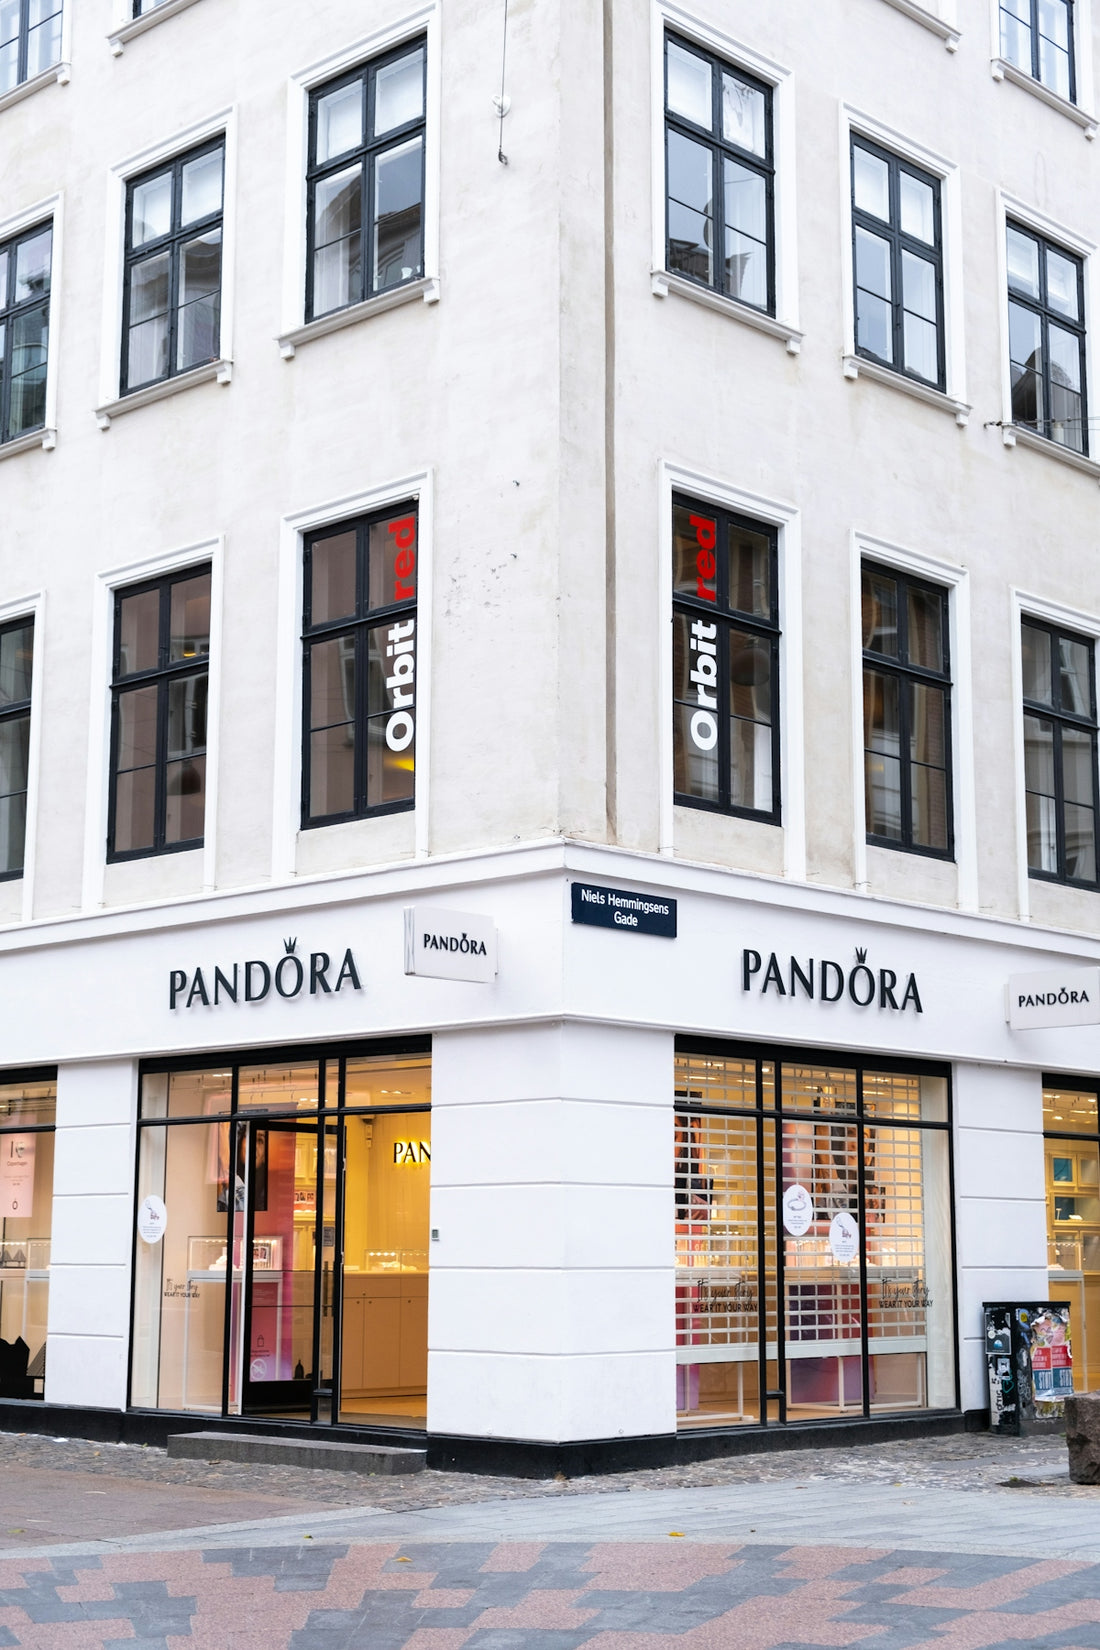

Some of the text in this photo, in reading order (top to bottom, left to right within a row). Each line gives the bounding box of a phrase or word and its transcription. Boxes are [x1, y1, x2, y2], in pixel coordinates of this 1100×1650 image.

[388, 516, 415, 600] red
[689, 515, 716, 602] red
[581, 888, 670, 915] Niels Hemmingsens
[613, 911, 639, 926] Gade
[424, 932, 487, 956] PANDORA
[169, 938, 362, 1010] PANDORA
[742, 947, 924, 1014] PANDORA
[1018, 987, 1090, 1008] PANDORA
[693, 1303, 758, 1312] WEAR IT YOUR WAY
[879, 1300, 896, 1308] WEAR
[904, 1300, 920, 1308] YOUR
[921, 1300, 933, 1308] WAY
